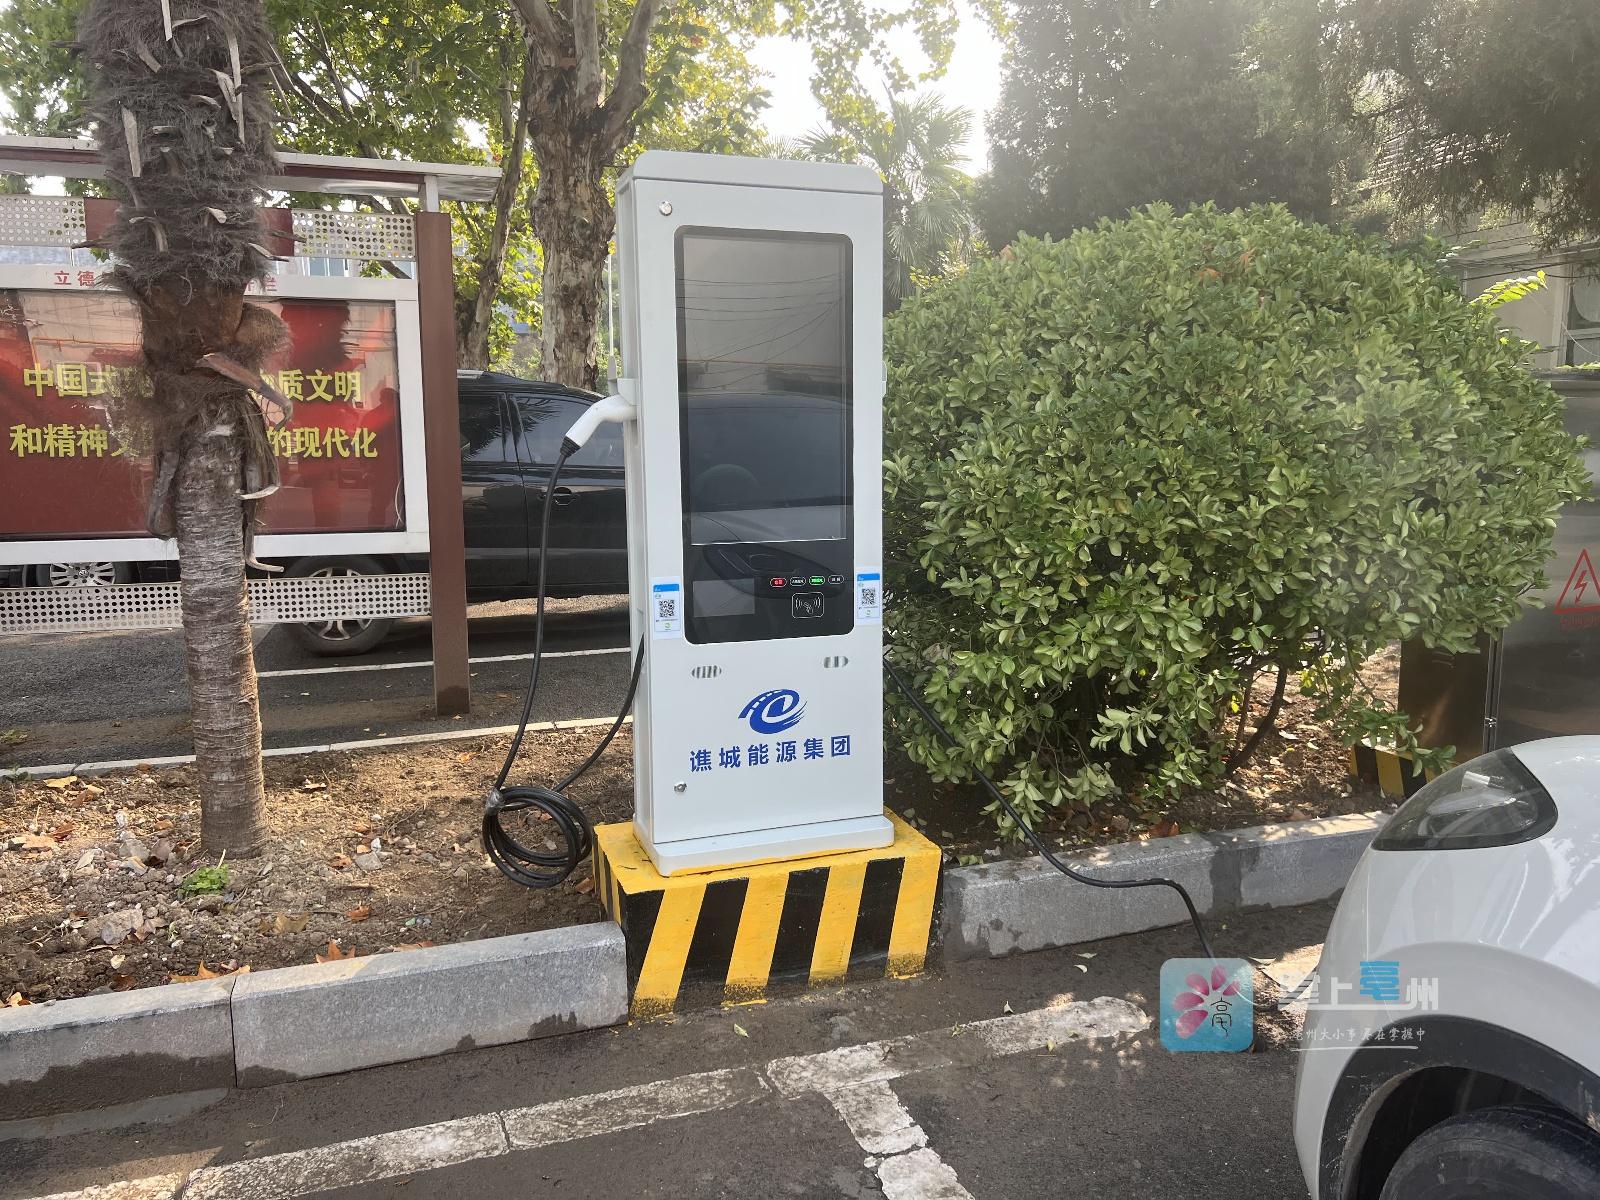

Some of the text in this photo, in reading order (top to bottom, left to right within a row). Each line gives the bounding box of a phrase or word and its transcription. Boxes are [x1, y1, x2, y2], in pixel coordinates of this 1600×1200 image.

[54, 270, 95, 287] 立德
[266, 426, 378, 458] 的现代化
[690, 735, 851, 772] 谯城能源集团
